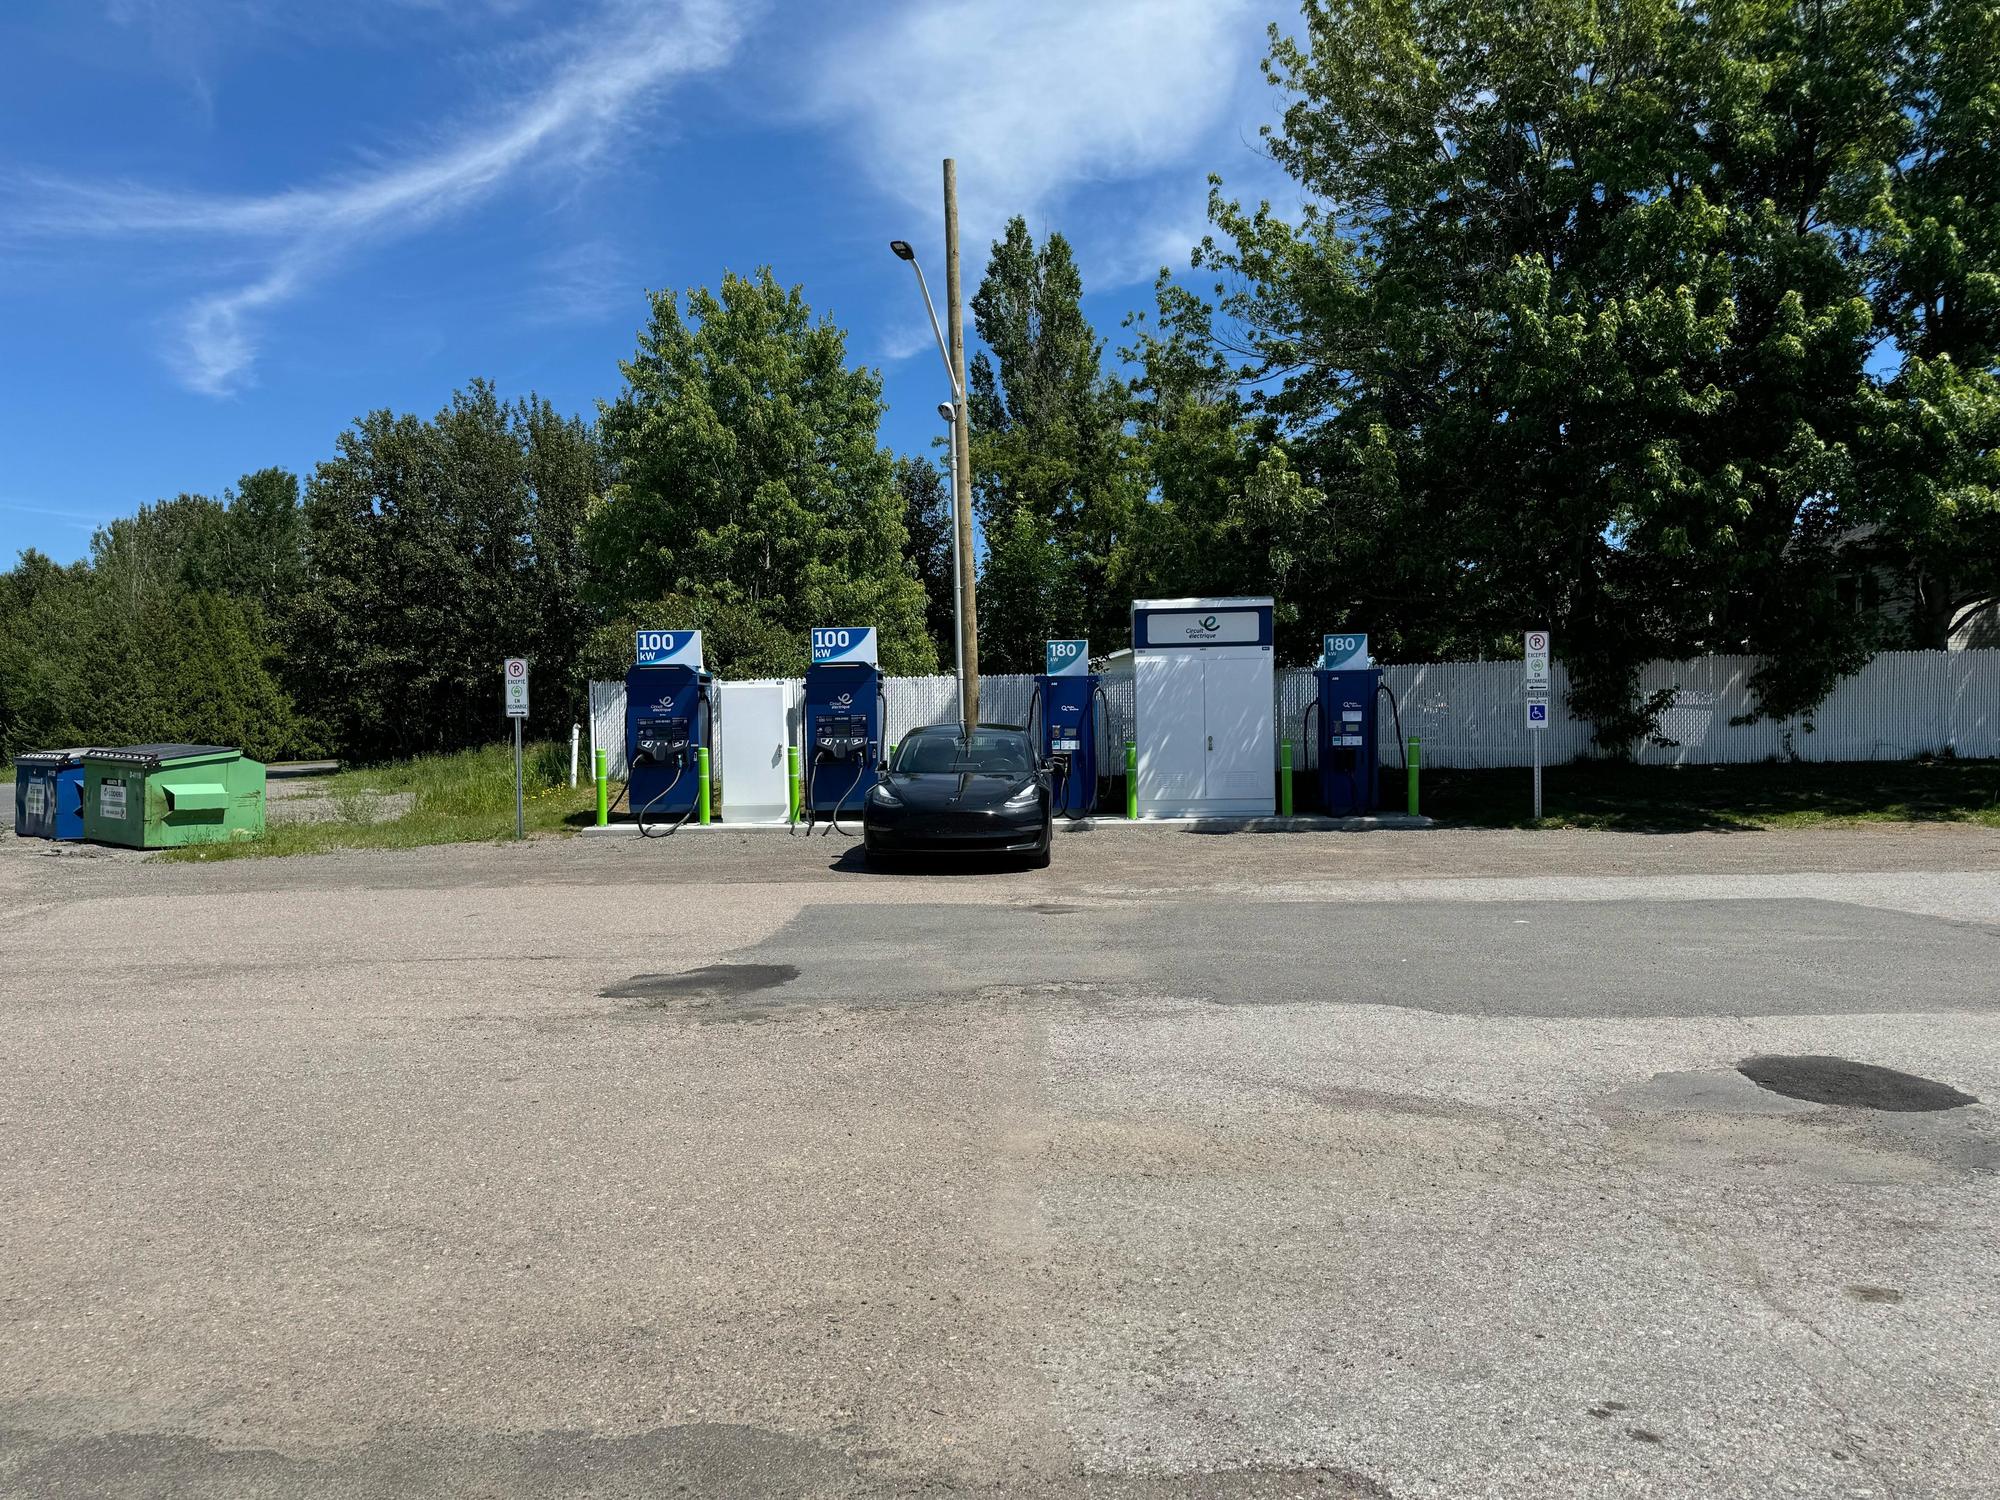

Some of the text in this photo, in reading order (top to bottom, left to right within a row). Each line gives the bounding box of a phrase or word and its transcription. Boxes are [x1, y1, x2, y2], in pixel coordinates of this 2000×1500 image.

[639, 633, 674, 651] 100
[814, 630, 850, 648] 100
[1327, 637, 1356, 651] 180
[639, 651, 656, 661] kW
[815, 648, 831, 658] kW
[1049, 643, 1077, 657] 180
